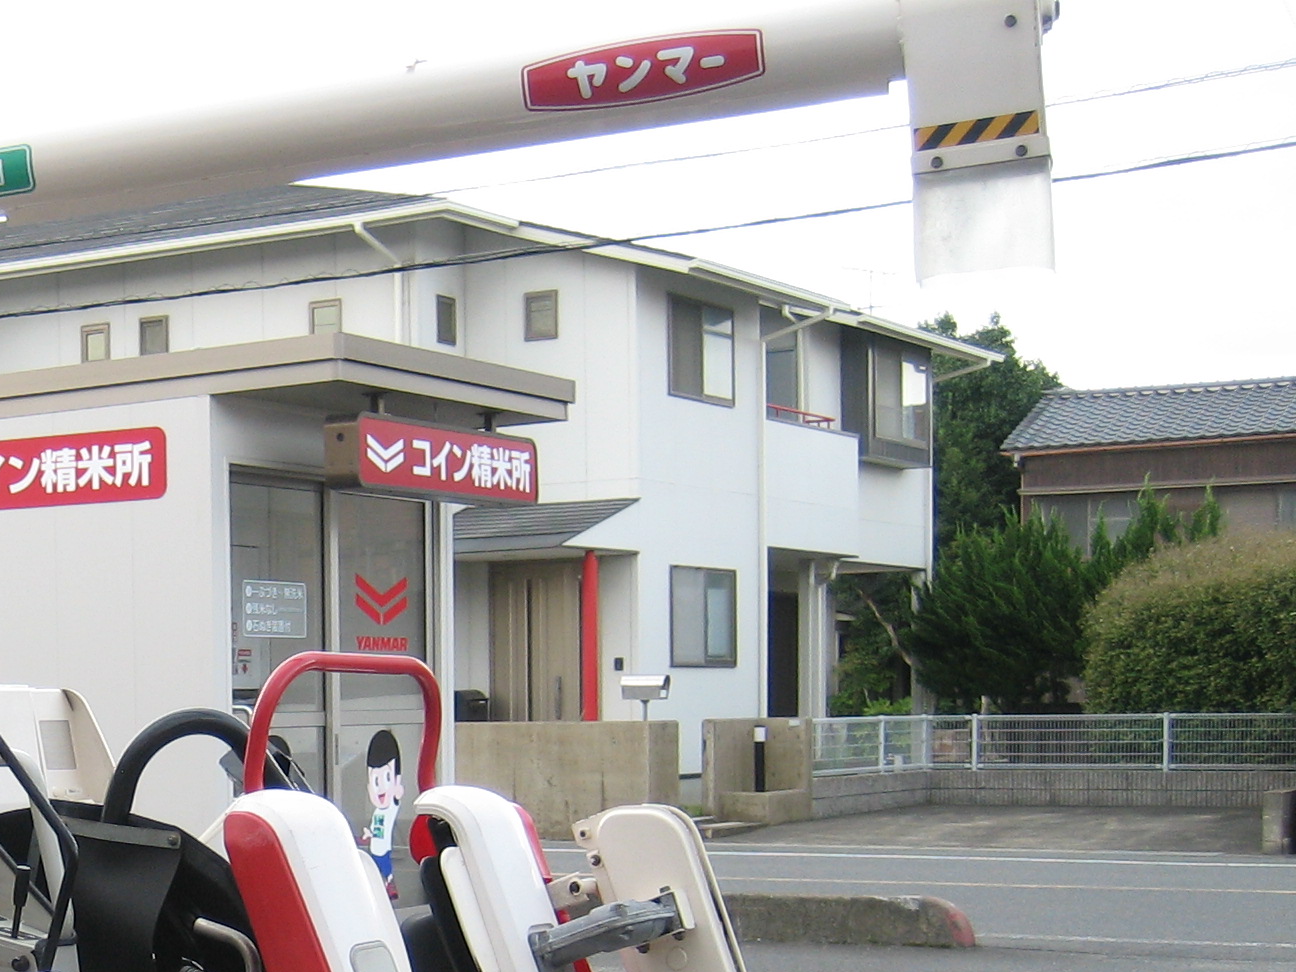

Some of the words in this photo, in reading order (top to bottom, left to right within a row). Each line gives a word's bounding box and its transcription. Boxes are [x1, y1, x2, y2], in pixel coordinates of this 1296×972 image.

[567, 46, 725, 99] ヤンマー
[412, 440, 531, 493] コイン精米所
[356, 636, 408, 651] YANMAR
